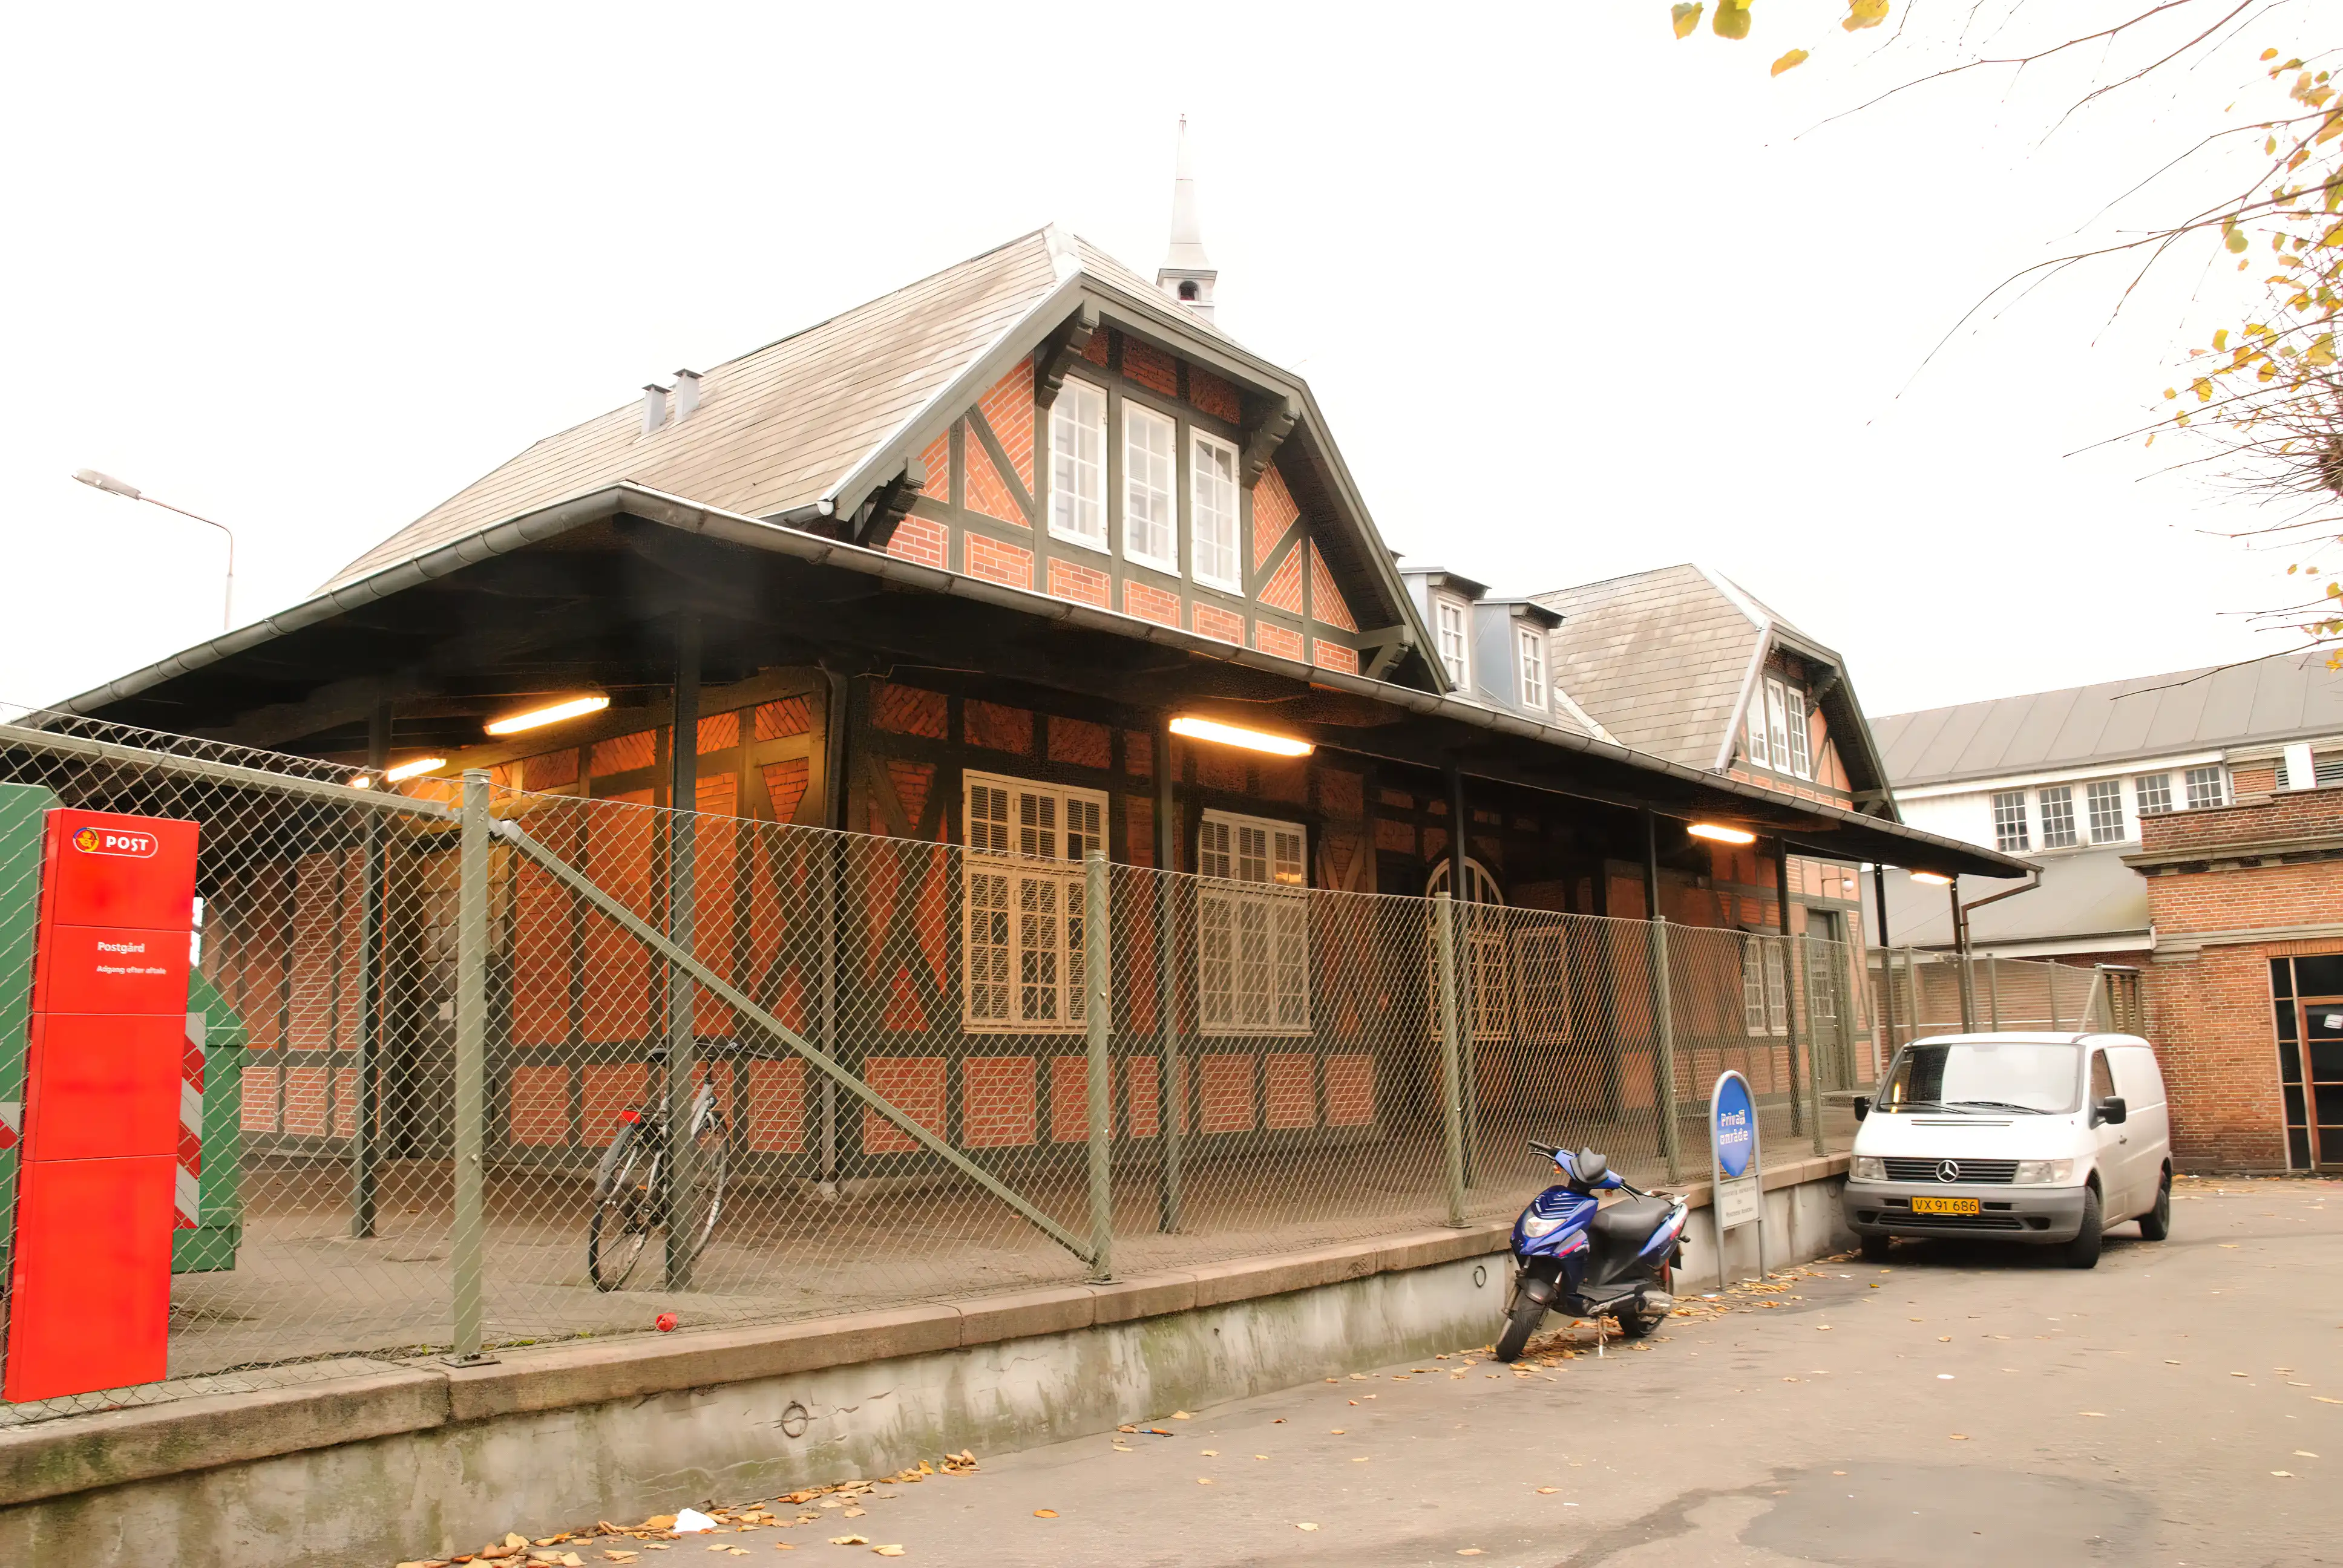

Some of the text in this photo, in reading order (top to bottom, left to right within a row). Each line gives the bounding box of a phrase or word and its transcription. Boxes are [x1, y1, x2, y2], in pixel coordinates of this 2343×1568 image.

[106, 835, 149, 852] POST
[97, 941, 145, 954] Postgård
[1915, 1200, 1977, 1212] VX 91 686
